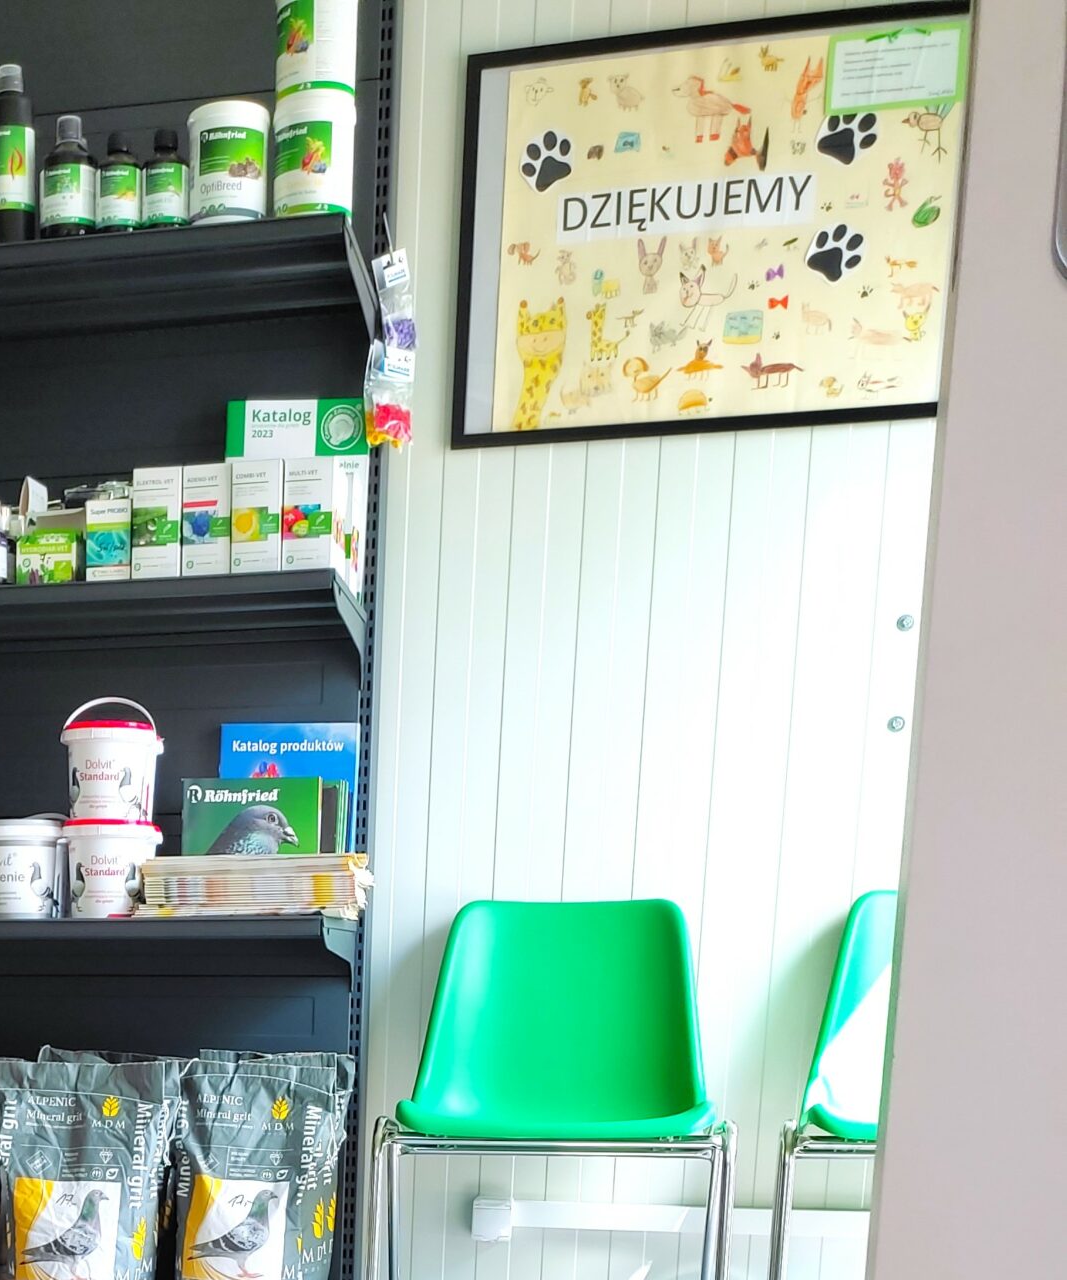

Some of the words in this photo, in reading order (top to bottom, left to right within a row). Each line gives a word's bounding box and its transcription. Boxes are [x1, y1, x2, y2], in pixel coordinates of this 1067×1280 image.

[200, 180, 243, 195] OptiBreed
[561, 174, 812, 232] DZIĘKUJEMY
[251, 407, 312, 426] Katalog
[251, 429, 274, 438] 2023
[232, 739, 278, 755] Katalog
[280, 740, 345, 756] produktów
[85, 759, 113, 770] Dolvit
[79, 772, 120, 782] Standard
[204, 788, 280, 805] Röhnfried
[90, 854, 119, 865] Dolvit
[84, 867, 126, 877] Standard
[27, 1095, 77, 1108] ALPENIC
[26, 1109, 66, 1122] Mineral
[67, 1113, 83, 1125] grit
[131, 1103, 153, 1171] Mineral
[300, 1105, 323, 1170] Mineral
[127, 1174, 145, 1210] grit
